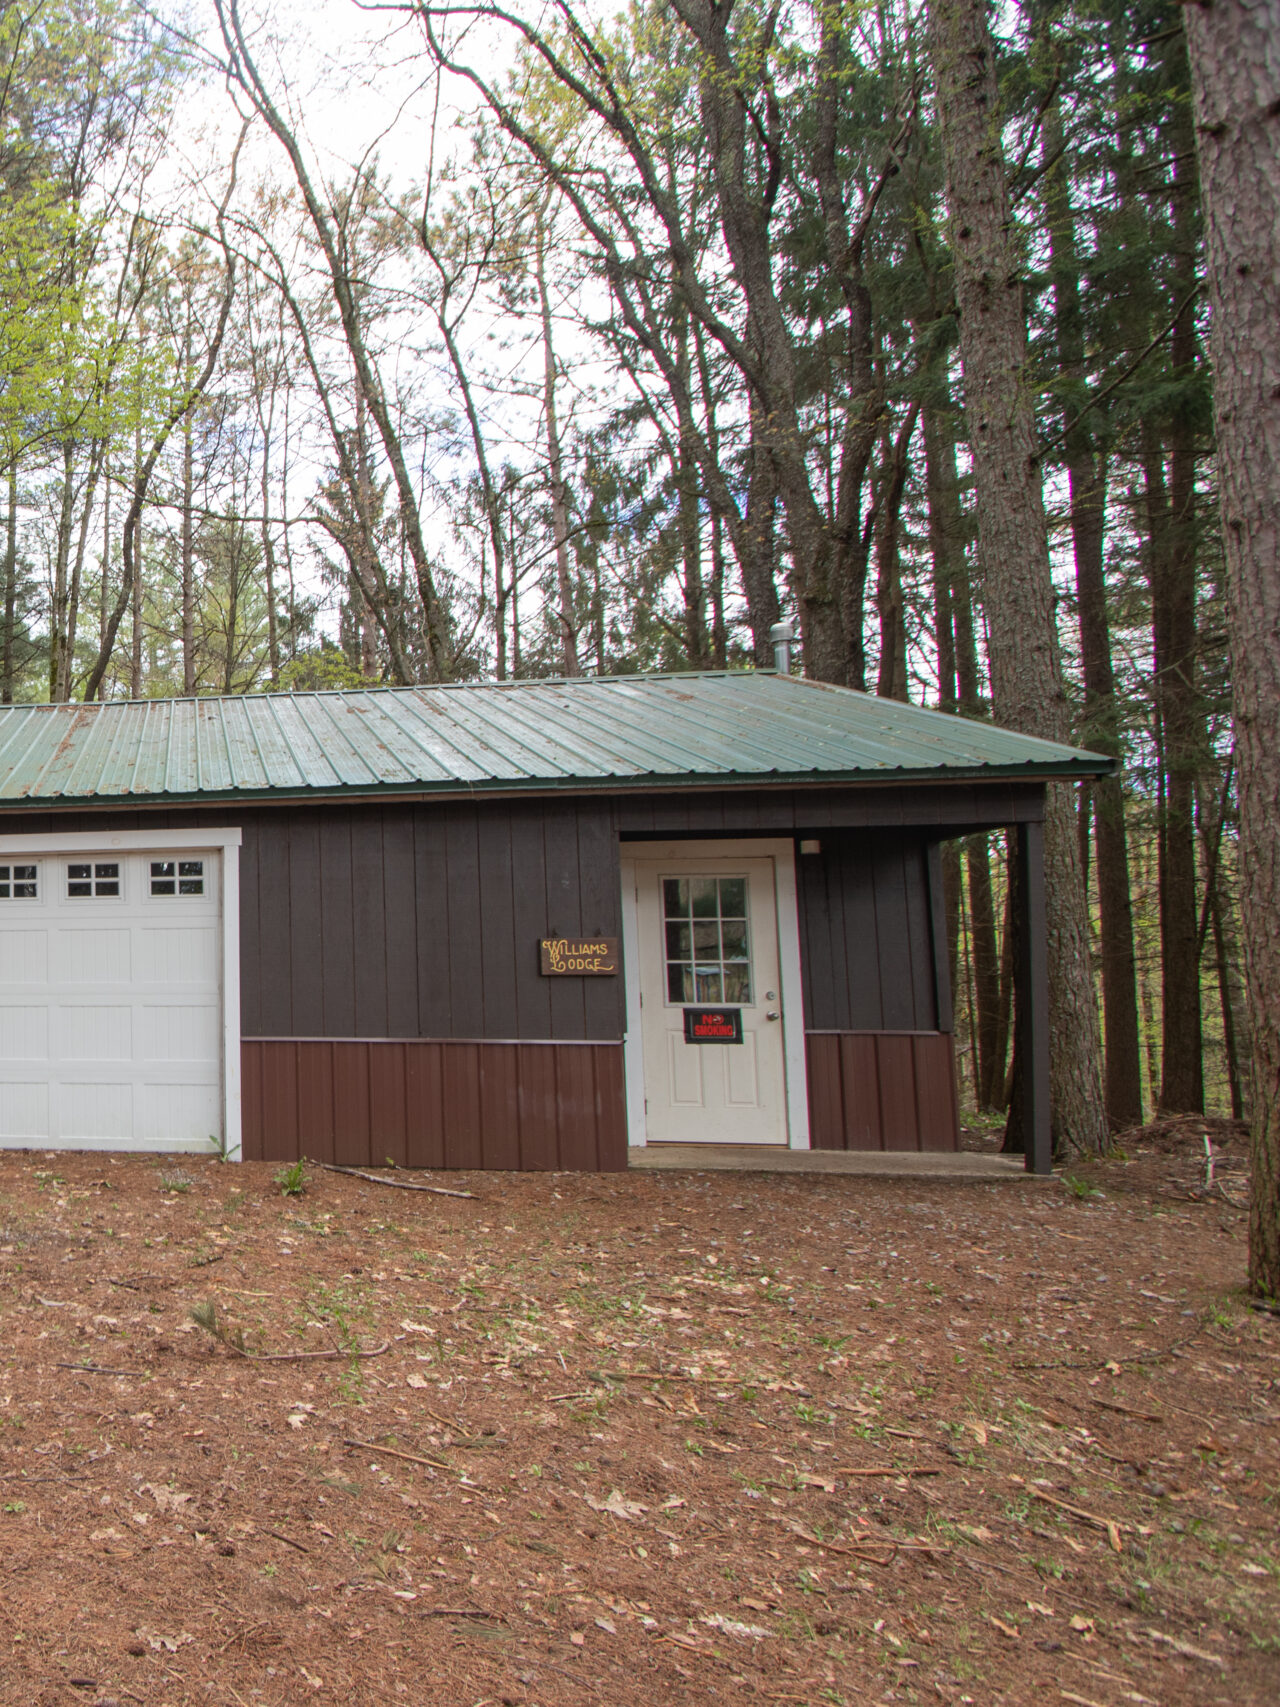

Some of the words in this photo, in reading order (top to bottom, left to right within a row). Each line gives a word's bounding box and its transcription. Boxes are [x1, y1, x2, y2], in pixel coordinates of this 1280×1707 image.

[542, 939, 608, 955] WILLIAMS
[550, 953, 614, 972] LODGE
[702, 1014, 724, 1025] NO
[695, 1025, 733, 1036] SMOKING
